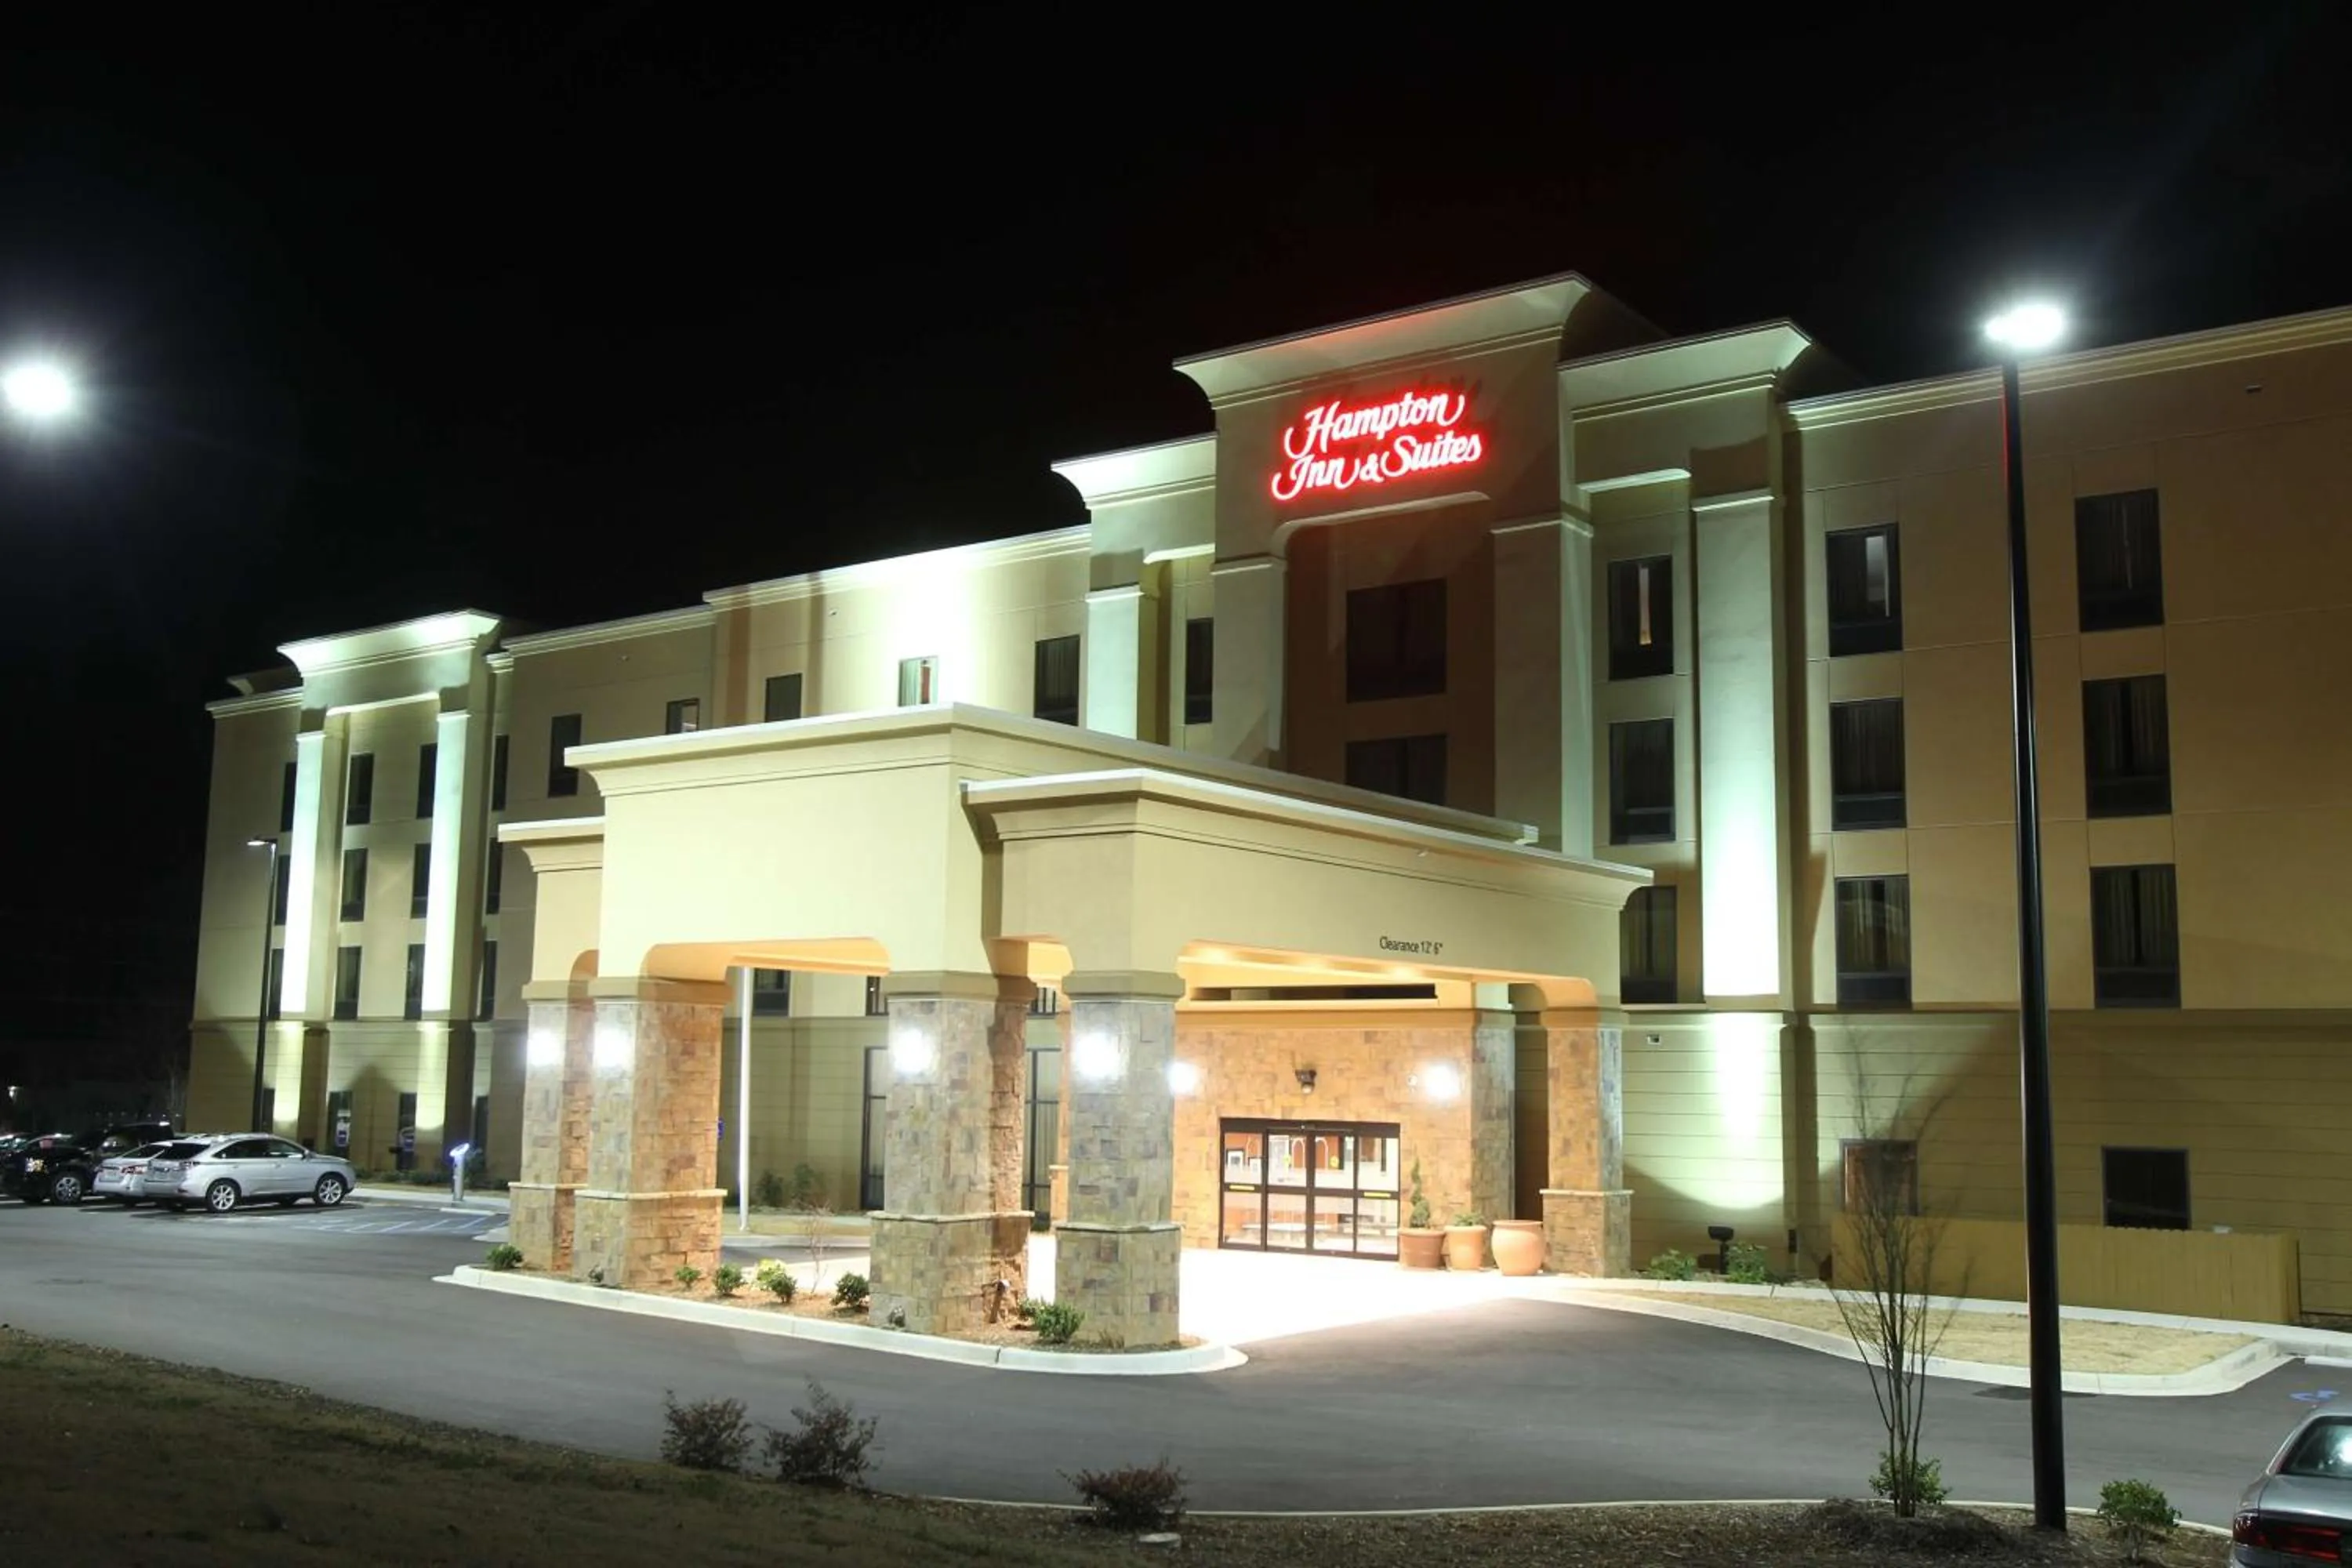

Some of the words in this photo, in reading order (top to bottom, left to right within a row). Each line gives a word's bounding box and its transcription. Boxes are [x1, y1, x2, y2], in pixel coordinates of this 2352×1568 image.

[1284, 392, 1465, 460] Hampton
[1272, 455, 1360, 500] Inn
[1360, 453, 1385, 482] &
[1381, 430, 1482, 477] Suites
[1379, 935, 1419, 953] Clearance
